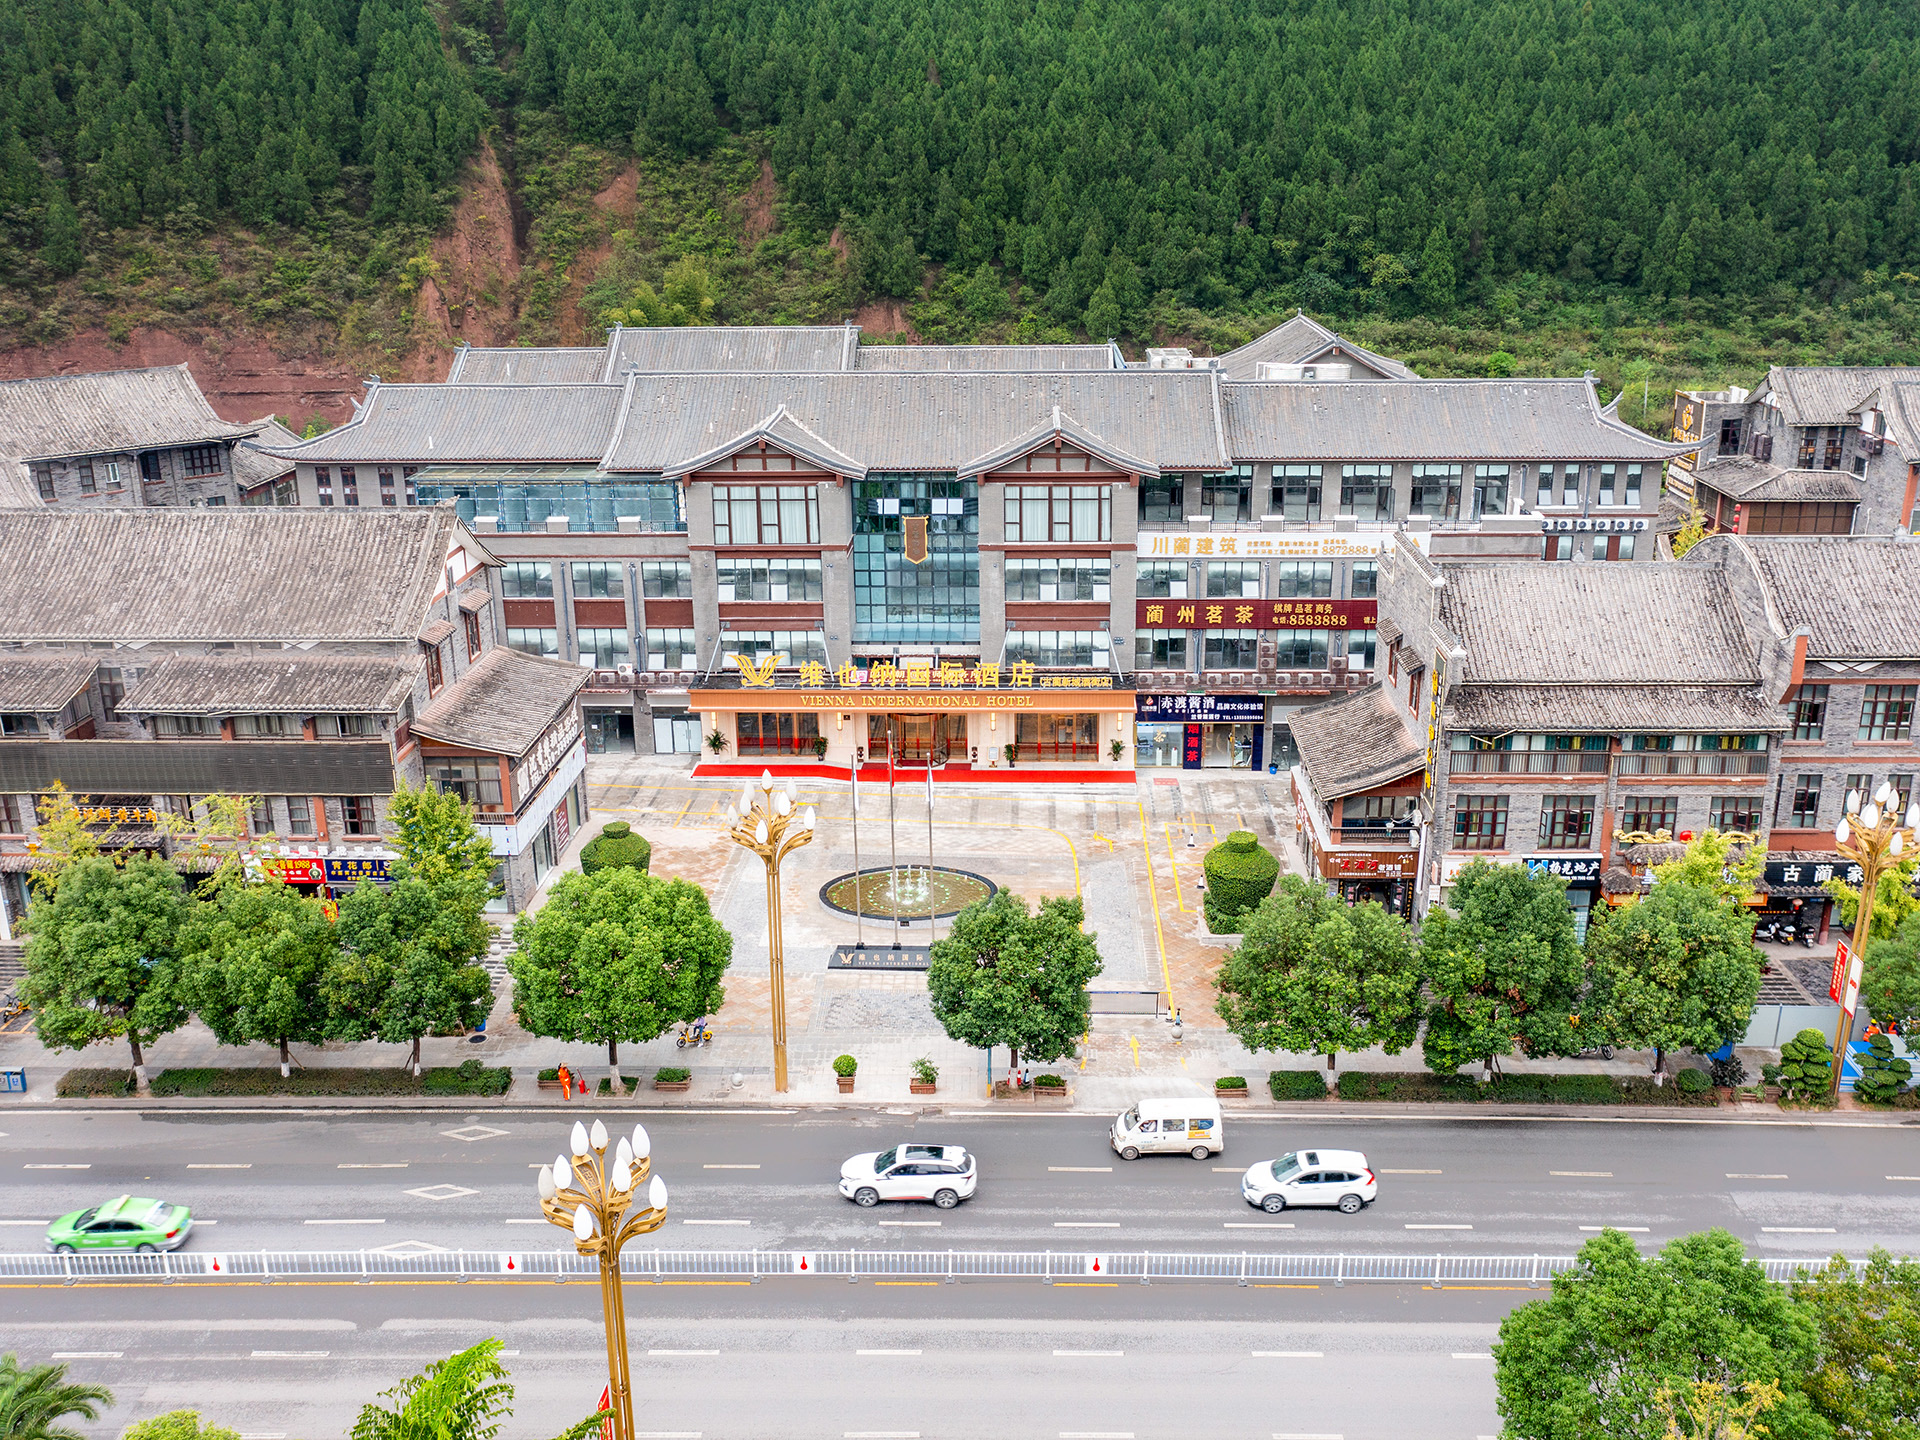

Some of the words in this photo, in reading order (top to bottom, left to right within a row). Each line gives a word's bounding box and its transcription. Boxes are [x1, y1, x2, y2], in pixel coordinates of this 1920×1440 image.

[1152, 537, 1238, 555] 川蔺建筑
[1322, 546, 1369, 556] 8872888
[1146, 605, 1254, 625] 蔺州茗茶
[799, 660, 1036, 687] 维也纳国际酒店
[800, 695, 856, 706] VIENNA
[861, 695, 980, 706] INTERNATIONAL
[986, 695, 1034, 706] HOTEL
[331, 861, 373, 870] 青花郎
